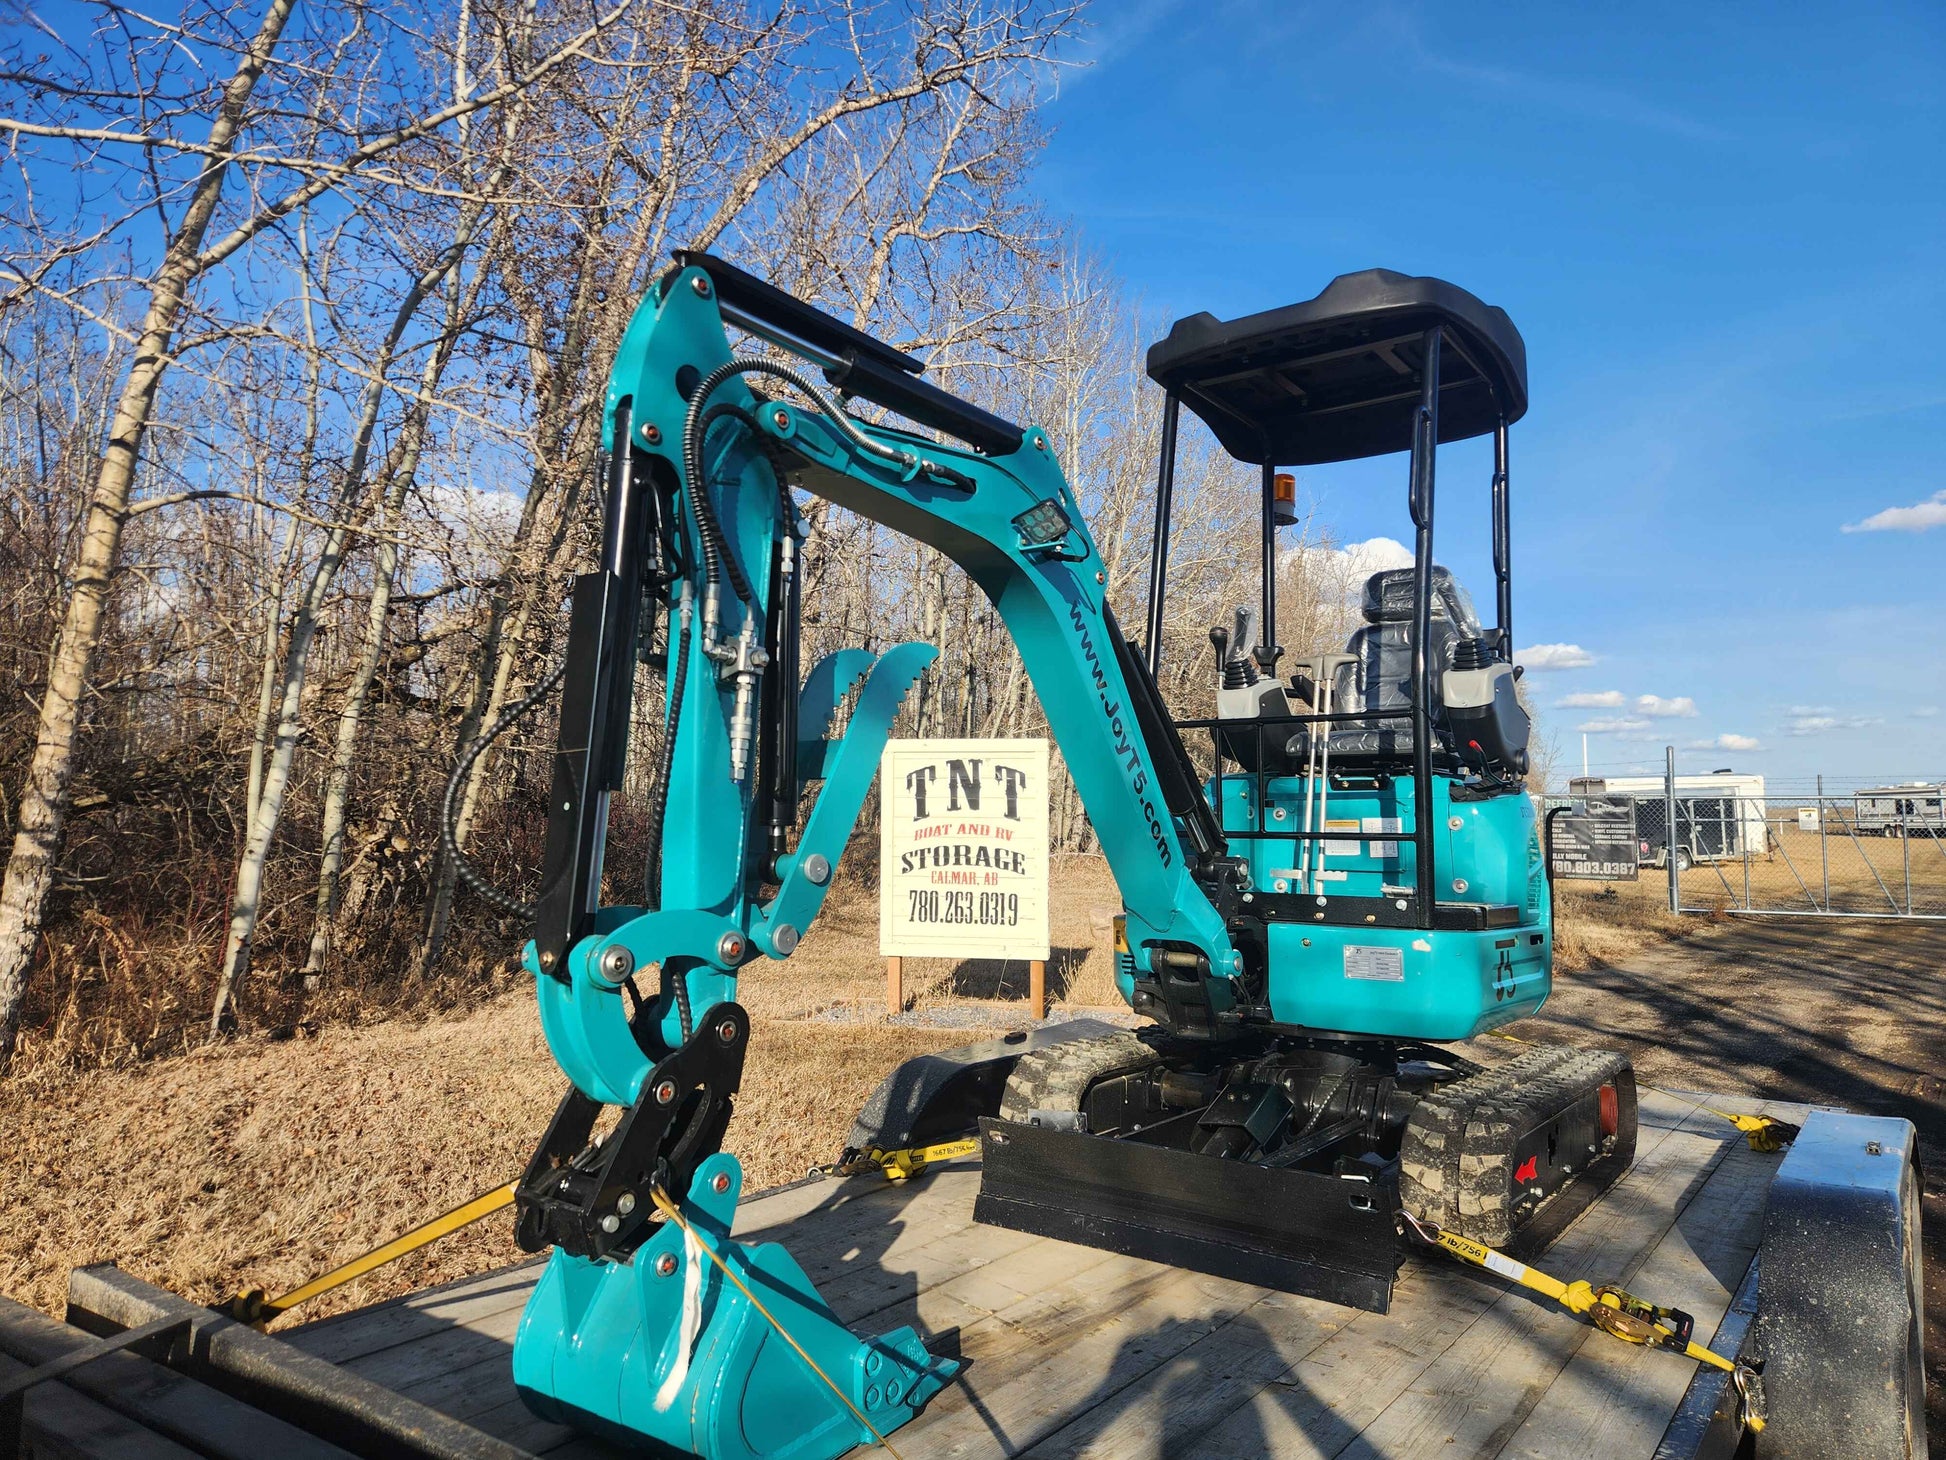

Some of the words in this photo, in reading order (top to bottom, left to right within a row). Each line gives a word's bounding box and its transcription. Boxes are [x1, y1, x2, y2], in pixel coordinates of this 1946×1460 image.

[1069, 604, 1172, 869] www.JoyT5.com
[906, 758, 1027, 822] TNT
[914, 824, 953, 841] BOAT
[957, 823, 990, 837] AND
[995, 827, 1014, 842] RV
[901, 844, 1026, 875] STORAGE
[931, 870, 980, 886] CALMAR,
[984, 872, 998, 886] AB
[909, 889, 1018, 927] 780.263.0319
